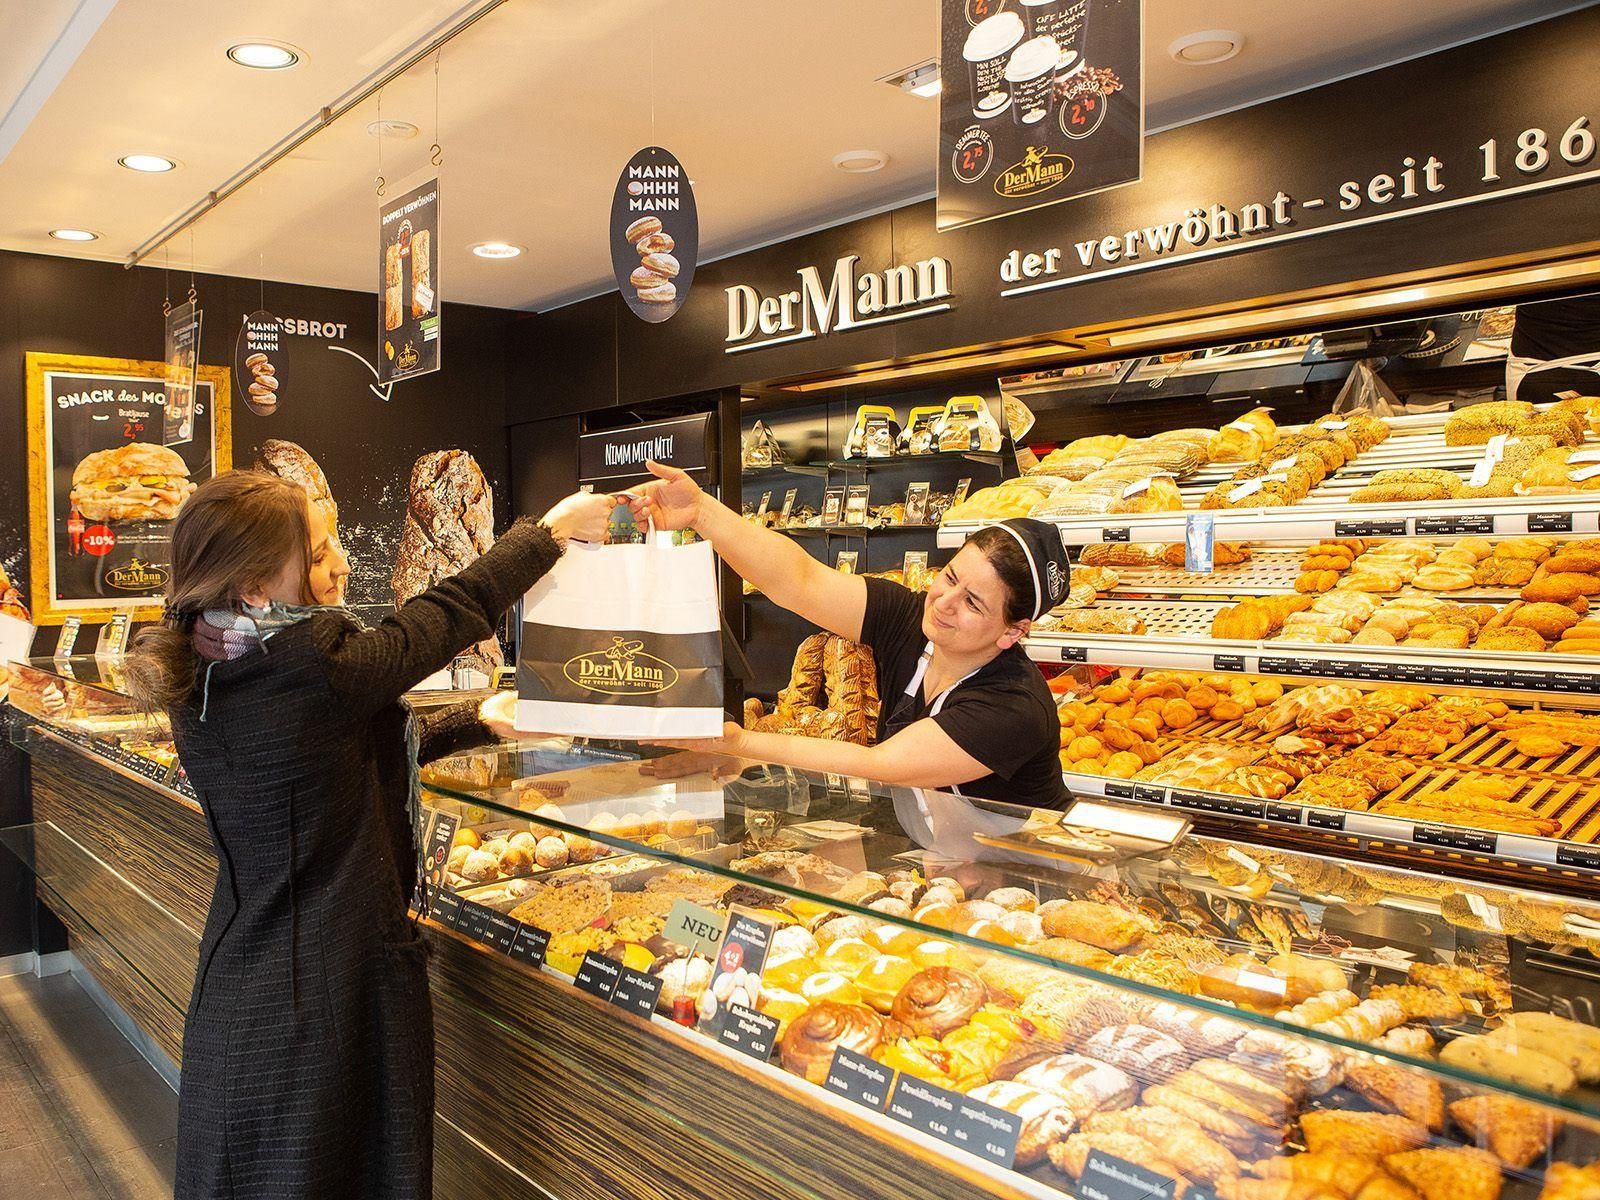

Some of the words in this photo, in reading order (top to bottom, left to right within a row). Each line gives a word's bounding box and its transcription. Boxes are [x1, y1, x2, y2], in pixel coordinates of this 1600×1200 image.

[1065, 81, 1100, 100] ESPRESSO
[629, 165, 679, 179] MANN
[1004, 161, 1064, 188] DerMann
[382, 206, 404, 226] DOPPELT
[403, 190, 437, 215] VERWÖHNEN
[629, 198, 680, 211] MANN
[1000, 249, 1061, 283] der
[1074, 190, 1291, 267] verwöhnt
[1339, 155, 1446, 212] seit
[1479, 116, 1596, 182] 186
[724, 254, 952, 342] DerMann
[247, 322, 279, 332] MANN
[247, 341, 279, 351] MANN
[57, 389, 115, 409] SNACK
[118, 390, 139, 402] des
[605, 442, 632, 466] NIMM
[632, 439, 654, 463] MICH
[654, 434, 674, 460] MIT!
[84, 535, 115, 546] -10%
[114, 570, 161, 583] DerMann
[579, 658, 663, 681] DerMann
[579, 678, 591, 686] der
[593, 679, 625, 687] verwöhnt
[681, 915, 723, 943] NEU
